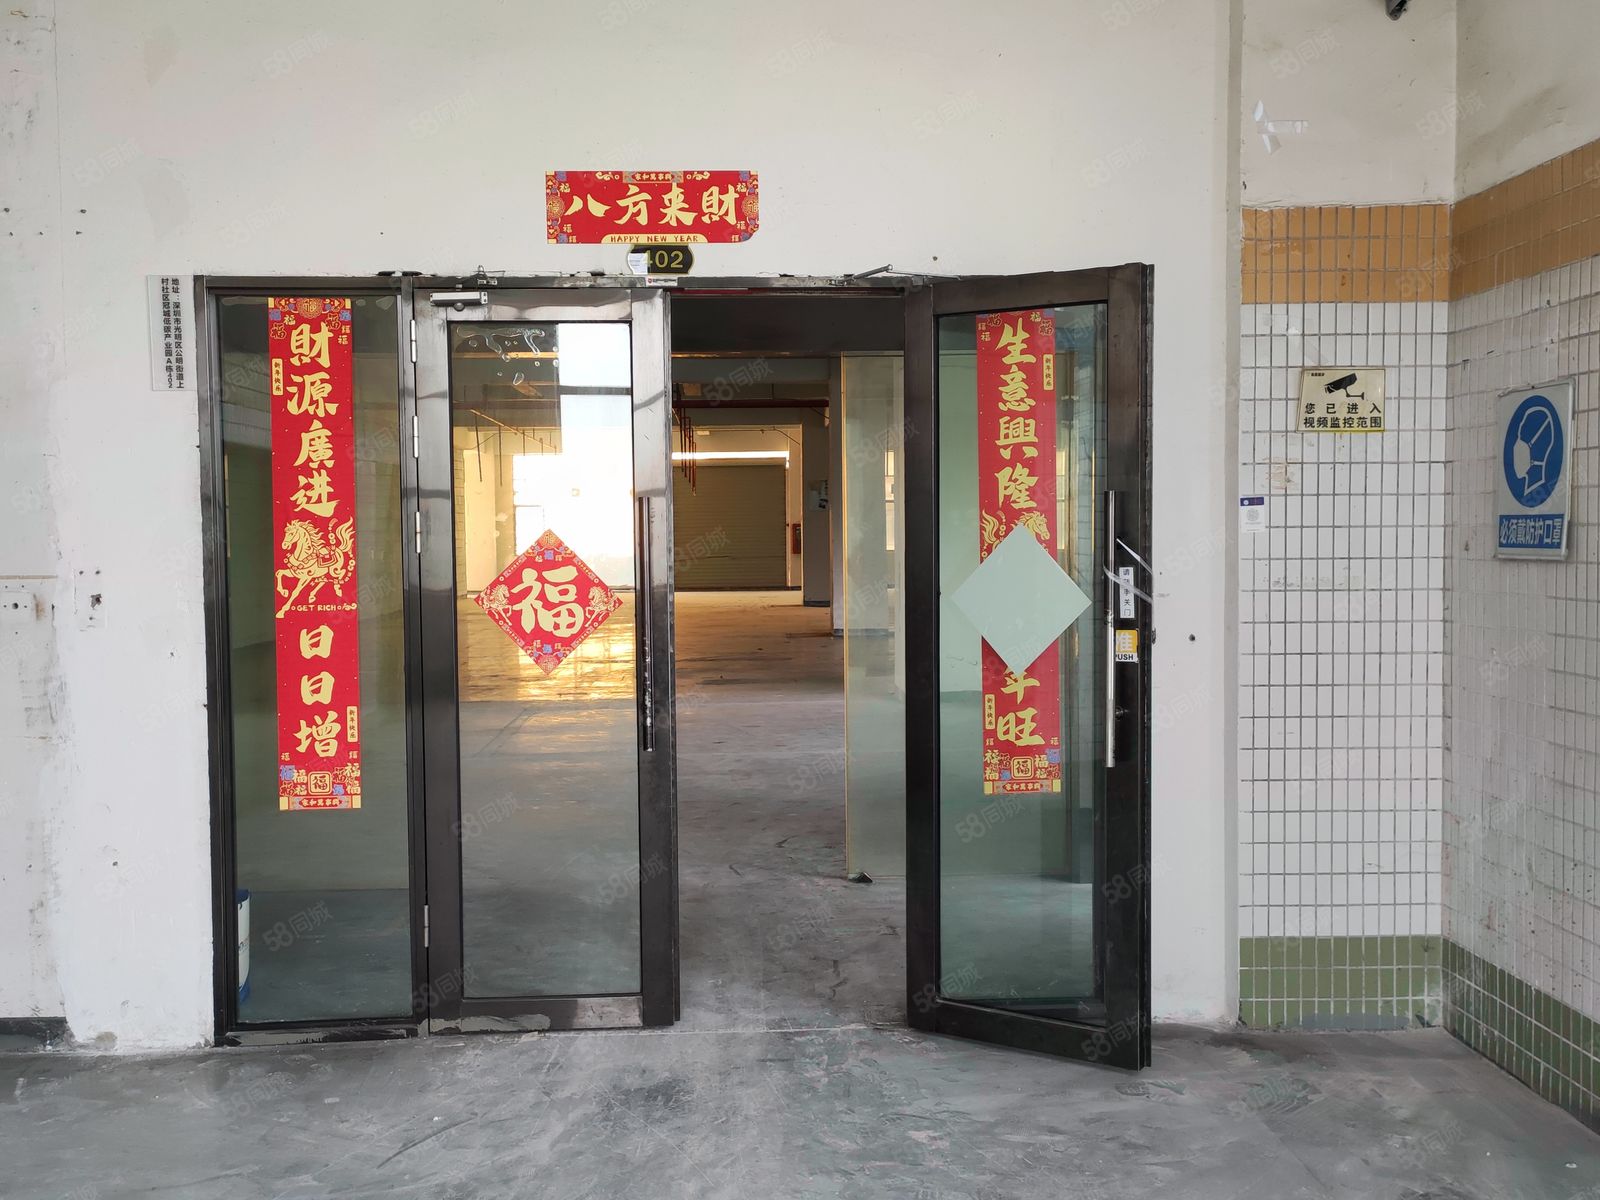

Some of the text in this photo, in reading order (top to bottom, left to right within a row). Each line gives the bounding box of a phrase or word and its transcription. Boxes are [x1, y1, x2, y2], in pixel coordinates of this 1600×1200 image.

[564, 182, 740, 227] 八方来財
[610, 235, 699, 243] HAPPY NEW YEAR
[1304, 403, 1382, 414] 您已进入
[1303, 416, 1382, 428] 视频监控范围
[1500, 518, 1563, 546] 必须戴防护口罩
[510, 565, 585, 638] 福
[296, 604, 337, 612] GET RICH
